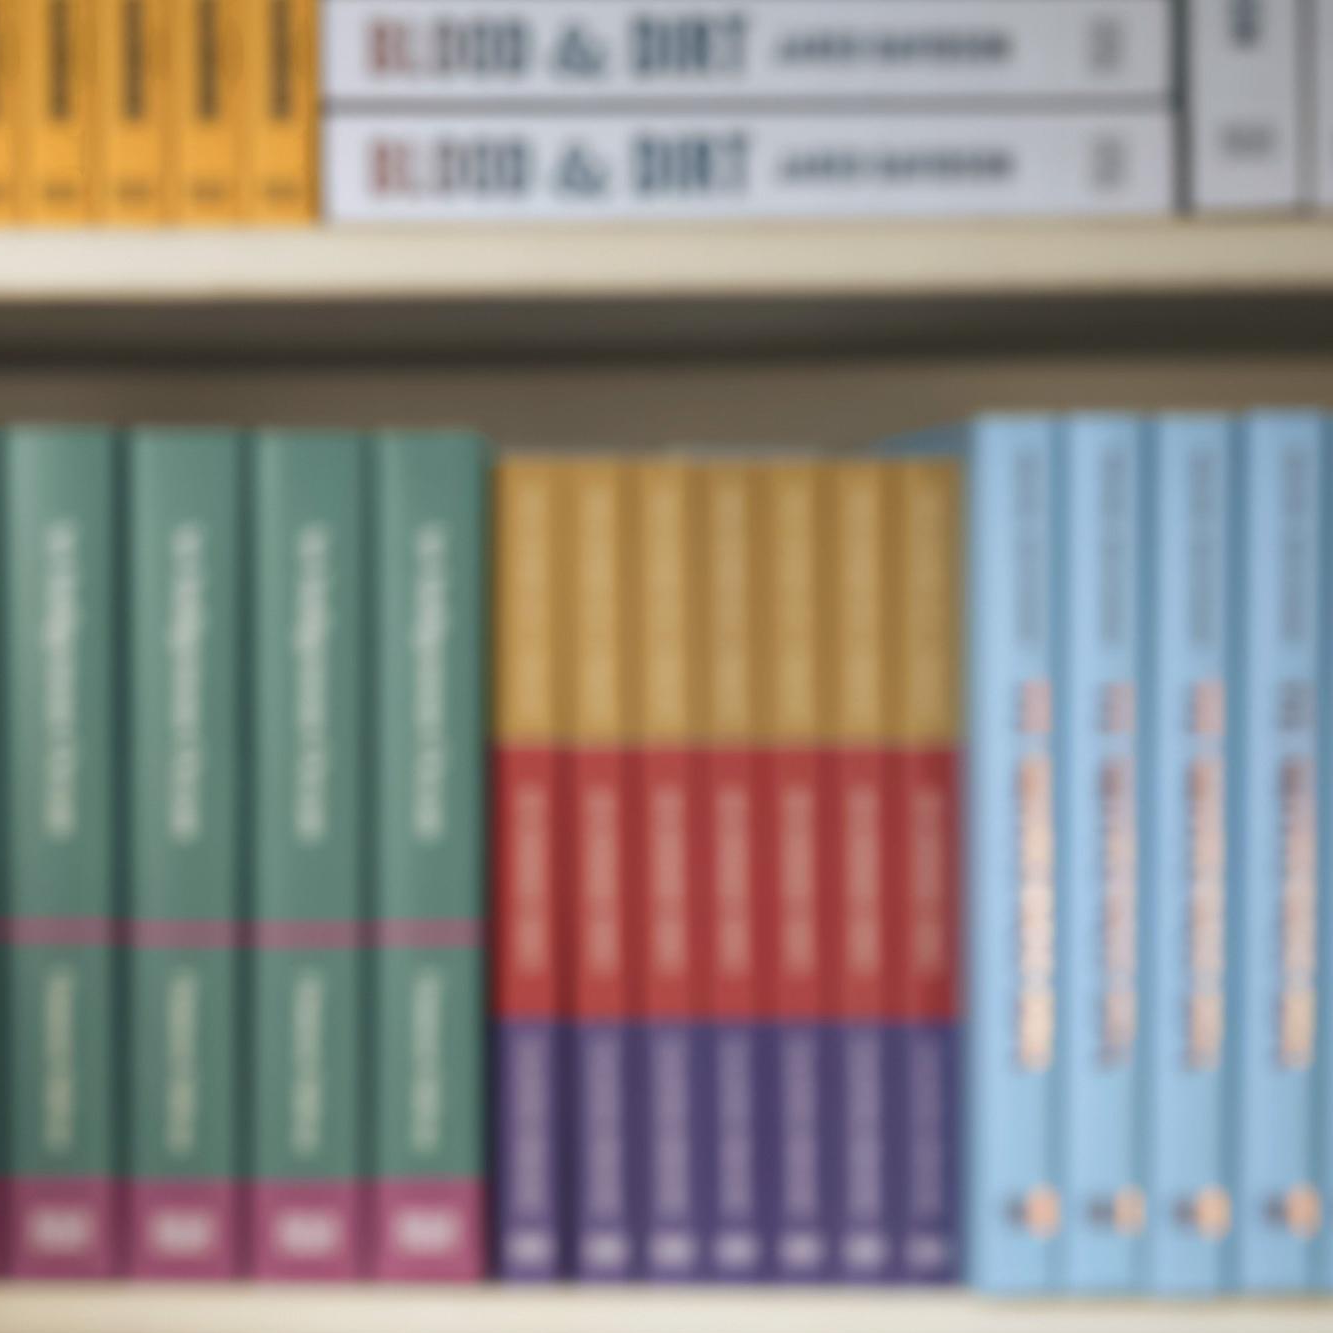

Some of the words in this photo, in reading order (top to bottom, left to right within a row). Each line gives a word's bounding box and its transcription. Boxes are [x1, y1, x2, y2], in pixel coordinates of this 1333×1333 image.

[369, 19, 527, 74] BLOOD
[552, 24, 610, 73] &
[632, 15, 746, 73] DIRT
[371, 138, 529, 194] BLOOD
[555, 144, 612, 194] &
[634, 131, 749, 194] DIRT
